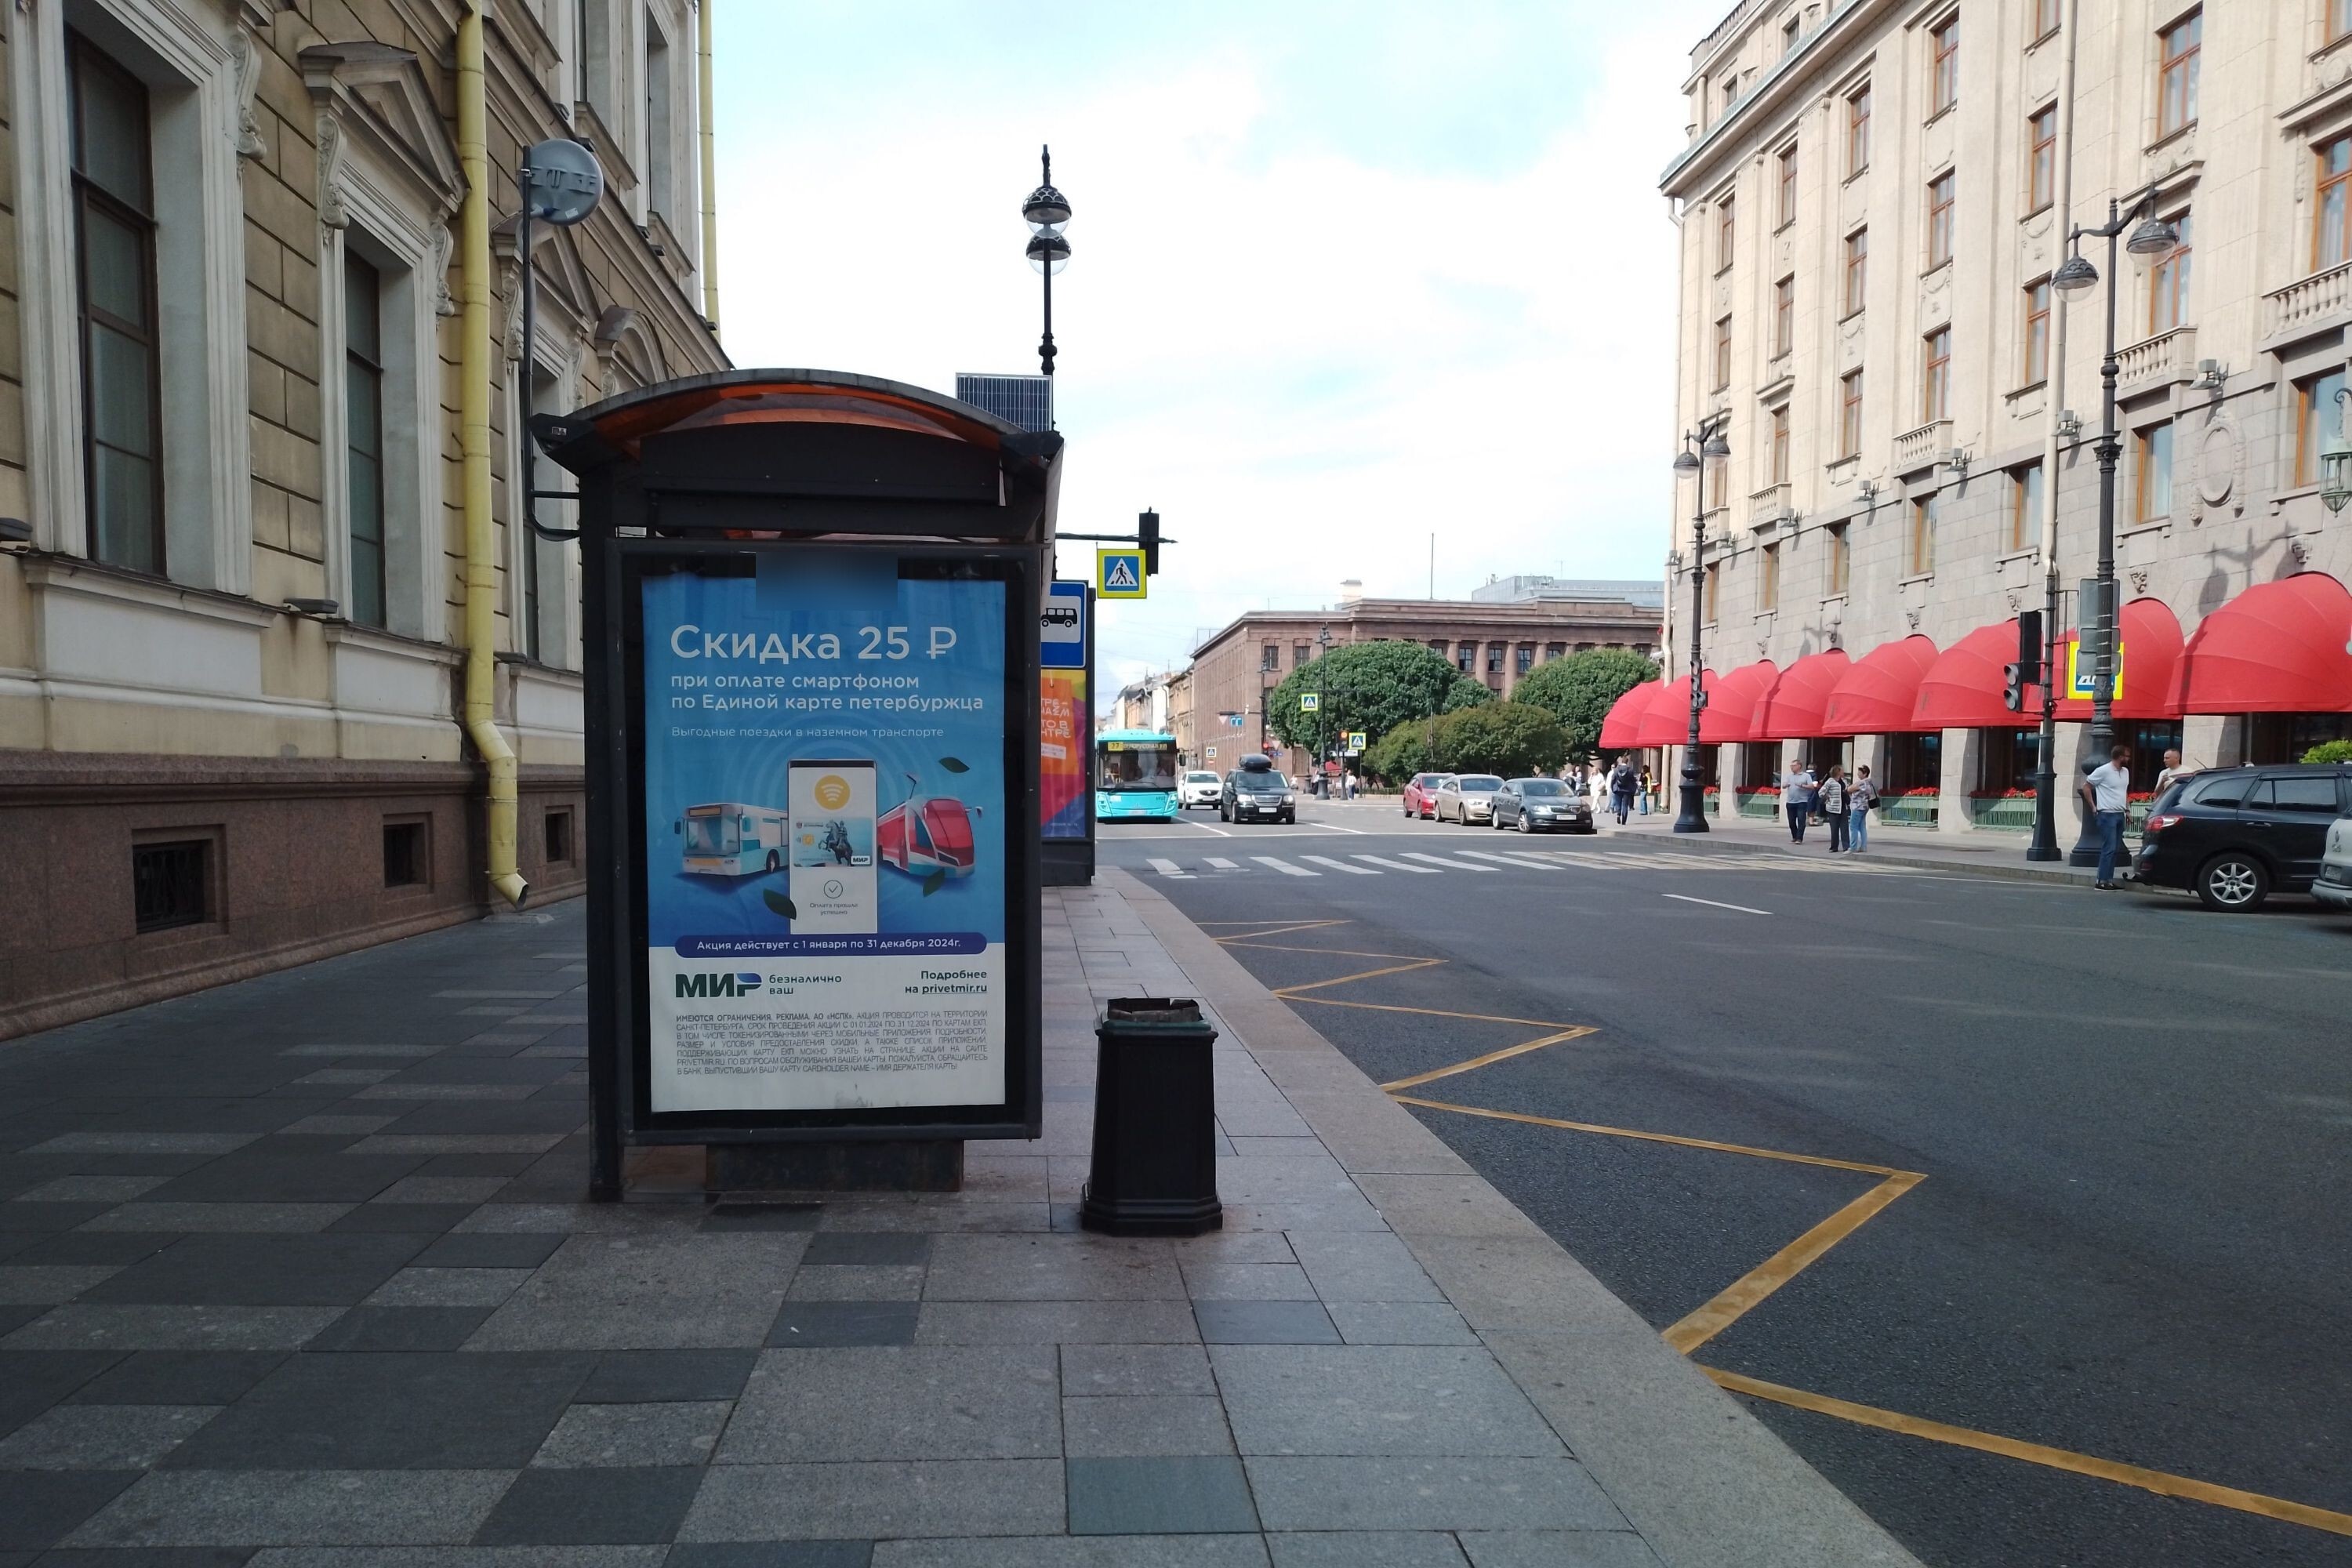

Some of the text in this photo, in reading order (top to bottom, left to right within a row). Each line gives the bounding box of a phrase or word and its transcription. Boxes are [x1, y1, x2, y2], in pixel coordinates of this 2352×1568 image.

[671, 625, 840, 665] Скидка
[858, 626, 909, 659] 25
[671, 673, 919, 691] при оплате смартфоном
[672, 694, 983, 712] по Единой карте петербуржца
[672, 727, 735, 738] Выгодные
[740, 728, 792, 738] поездки
[872, 728, 944, 739] транспорте
[697, 942, 731, 950] Акция
[735, 941, 790, 951] действует
[802, 940, 806, 949] 1
[810, 941, 848, 949] января
[880, 939, 924, 949] декабря
[927, 938, 961, 947] 2024г.
[769, 975, 842, 984] безналично
[921, 971, 988, 981] Подробнее
[675, 973, 762, 998] МИР
[770, 986, 793, 995] ваш
[922, 984, 988, 995] privetmir.ru
